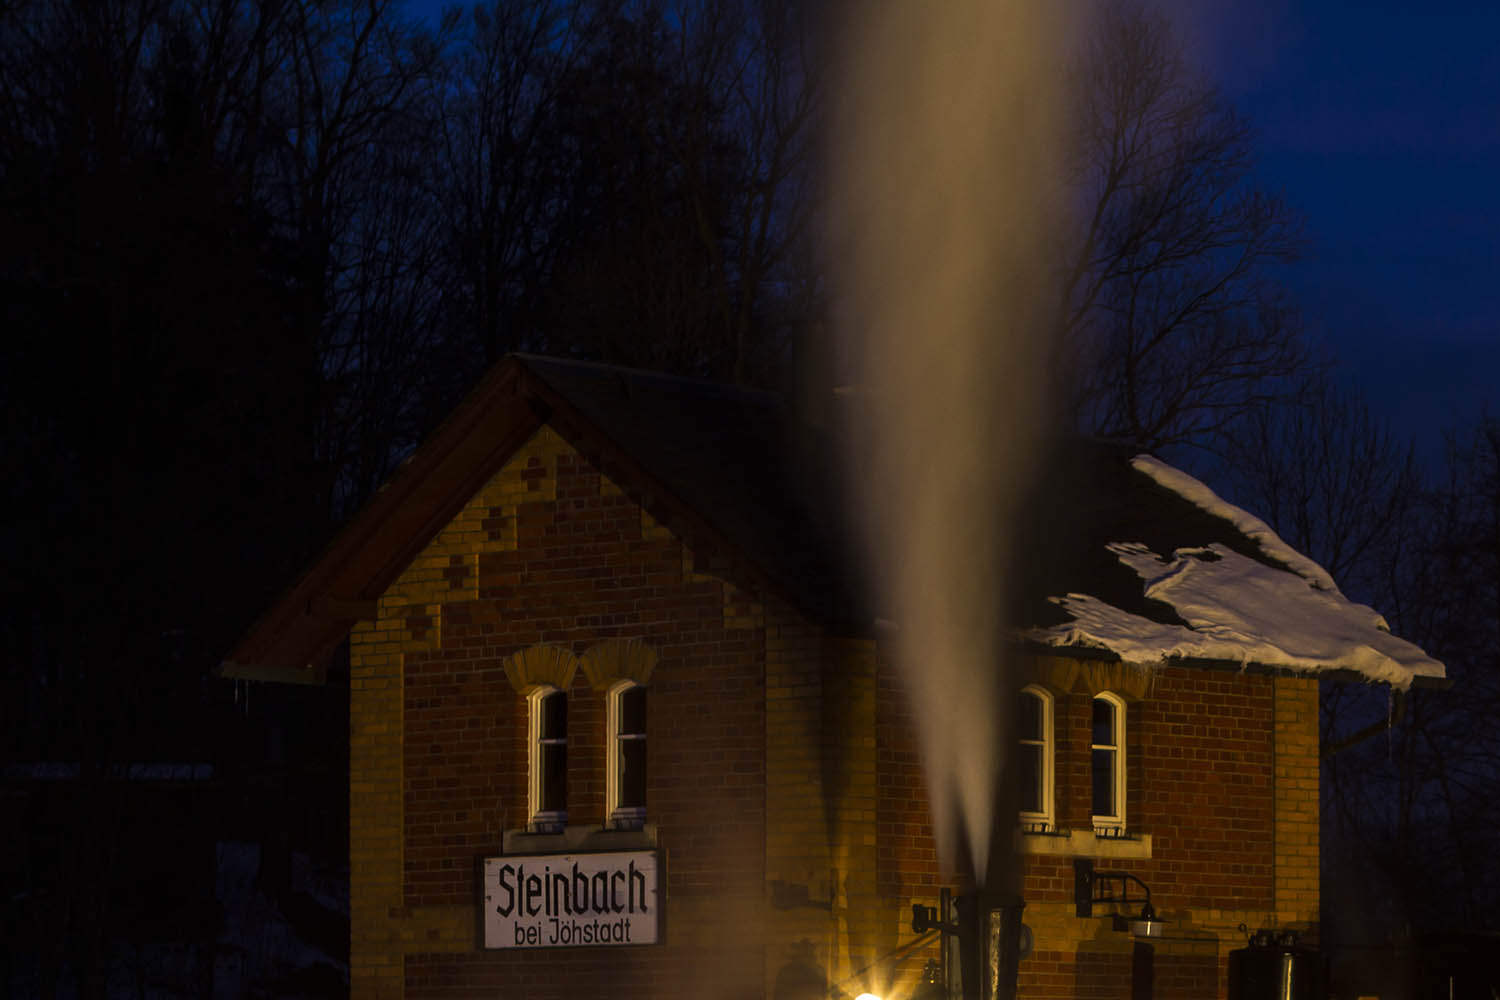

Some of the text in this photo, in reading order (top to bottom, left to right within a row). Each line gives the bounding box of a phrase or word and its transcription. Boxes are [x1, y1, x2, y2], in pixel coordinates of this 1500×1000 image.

[496, 859, 648, 918] Steinbach
[514, 917, 632, 945] bei Jöhstadt
